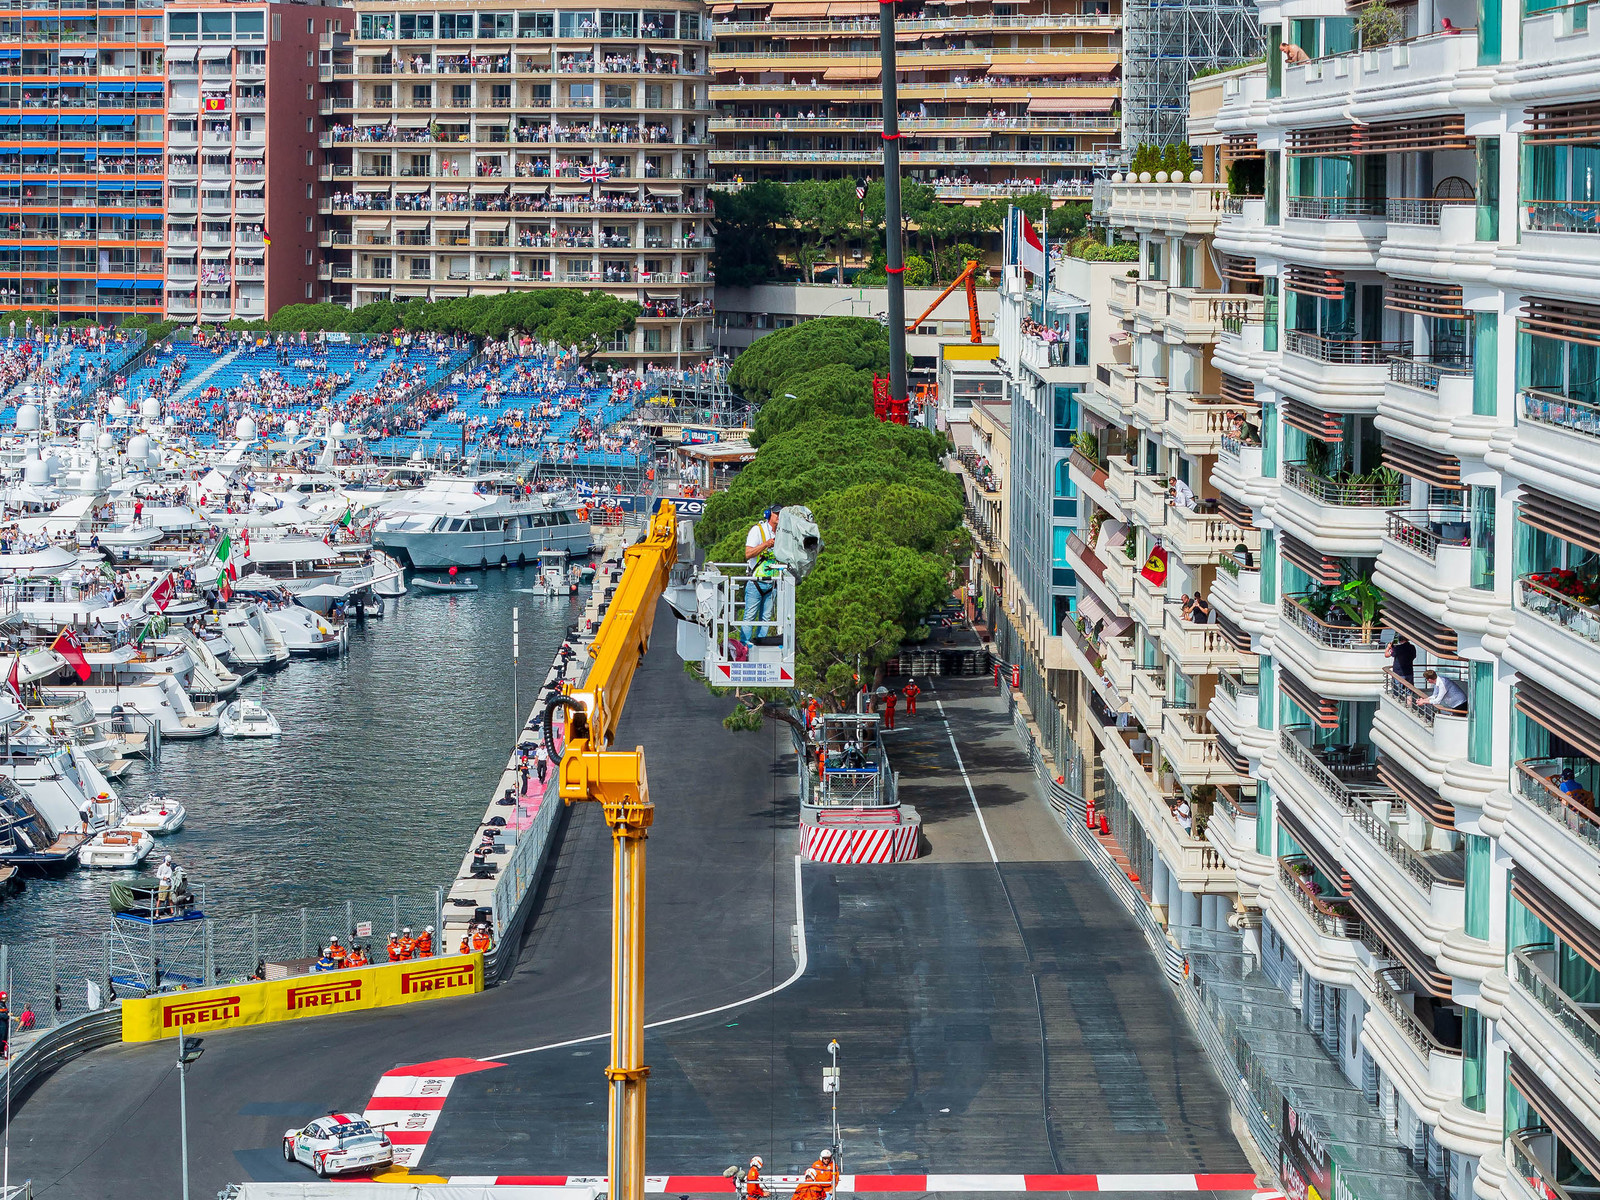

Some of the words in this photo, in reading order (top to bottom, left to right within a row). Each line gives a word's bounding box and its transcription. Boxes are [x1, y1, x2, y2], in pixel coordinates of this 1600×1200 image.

[287, 979, 362, 1011] PIRELLI
[402, 964, 474, 995] PIRELLI
[163, 996, 240, 1028] PIRELLI
